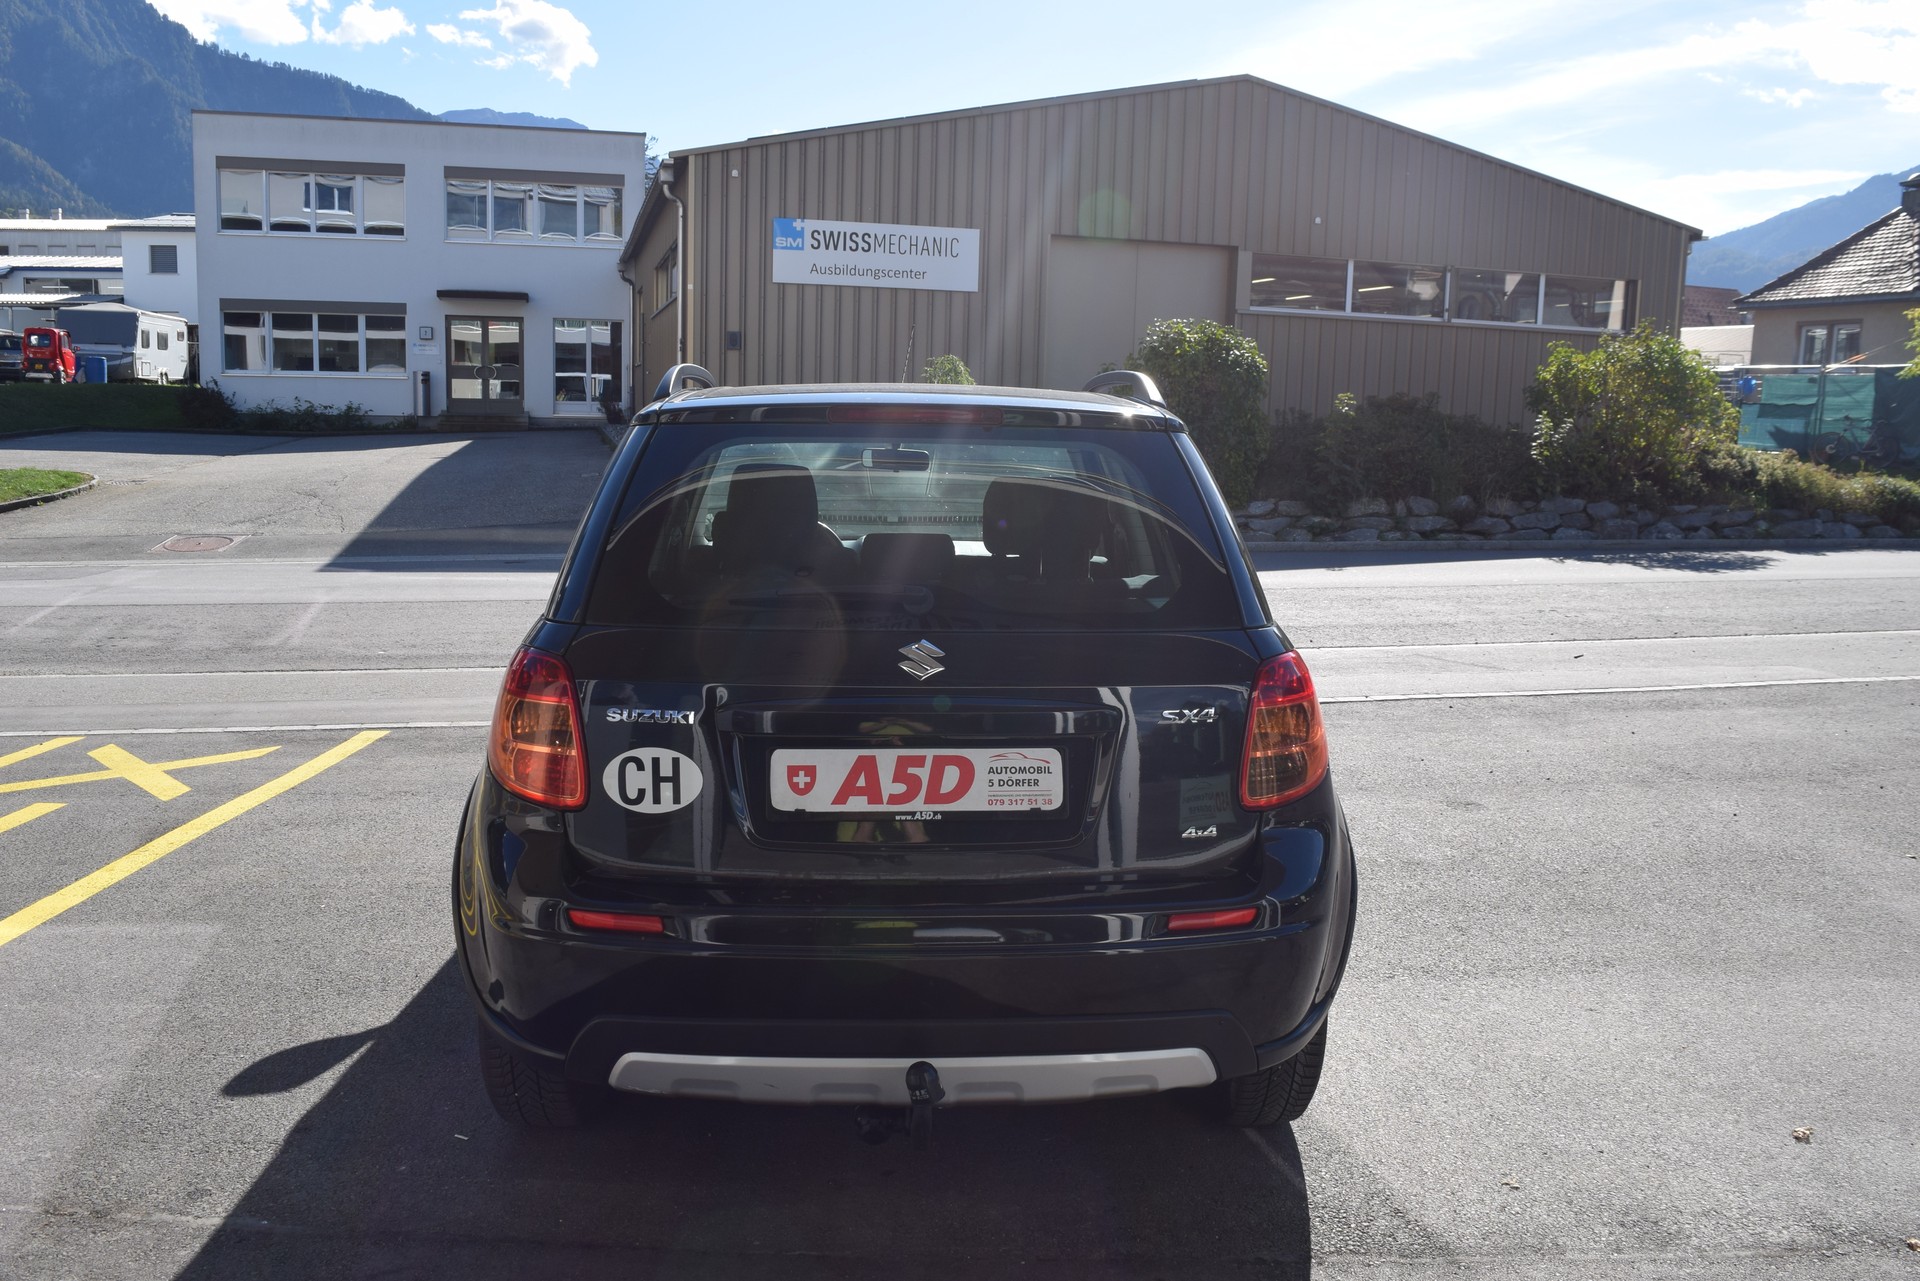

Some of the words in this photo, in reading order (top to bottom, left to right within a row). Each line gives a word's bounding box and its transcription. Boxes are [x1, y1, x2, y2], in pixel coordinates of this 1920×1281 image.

[775, 237, 802, 247] SM
[810, 229, 960, 258] SWISSMECHANIC
[809, 263, 927, 280] Ausbildungscenter
[606, 707, 695, 725] SUZUKI
[1157, 706, 1219, 724] SX4
[987, 766, 1053, 775] AUTOMOBIL
[617, 755, 681, 806] CH
[830, 754, 976, 806] A5D
[988, 779, 994, 787] 5
[998, 776, 1040, 787] DÖRFER
[988, 798, 1005, 806] 079
[1008, 798, 1025, 806] 317
[1027, 798, 1038, 806] 51
[1041, 798, 1053, 806] 38
